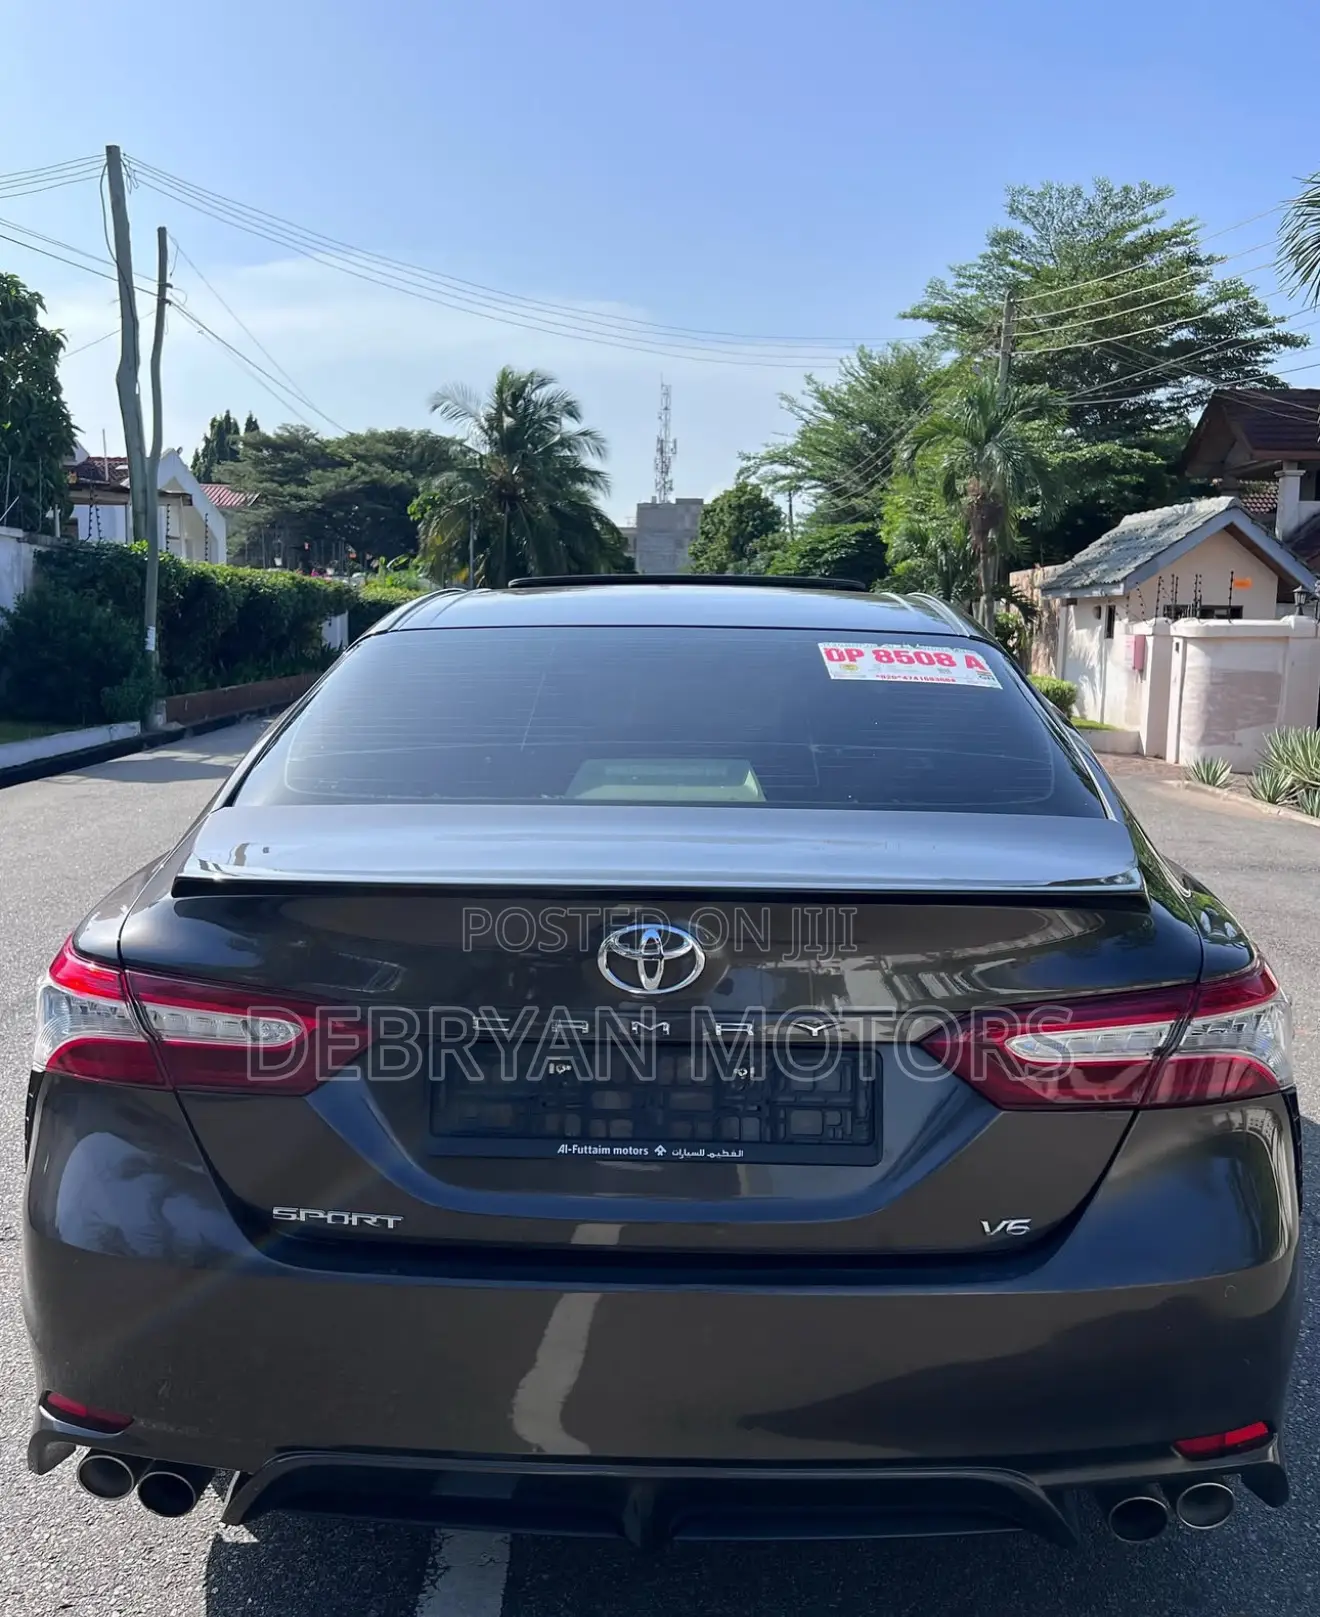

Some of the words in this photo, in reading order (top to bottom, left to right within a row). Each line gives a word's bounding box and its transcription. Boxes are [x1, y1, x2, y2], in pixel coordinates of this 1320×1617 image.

[824, 648, 864, 663] DP
[872, 649, 957, 667] 8508
[965, 655, 987, 671] A
[557, 1144, 611, 1155] Al-Futtaim
[613, 1146, 649, 1156] motors
[272, 1206, 404, 1229] SPORT
[980, 1219, 1032, 1236] V6
